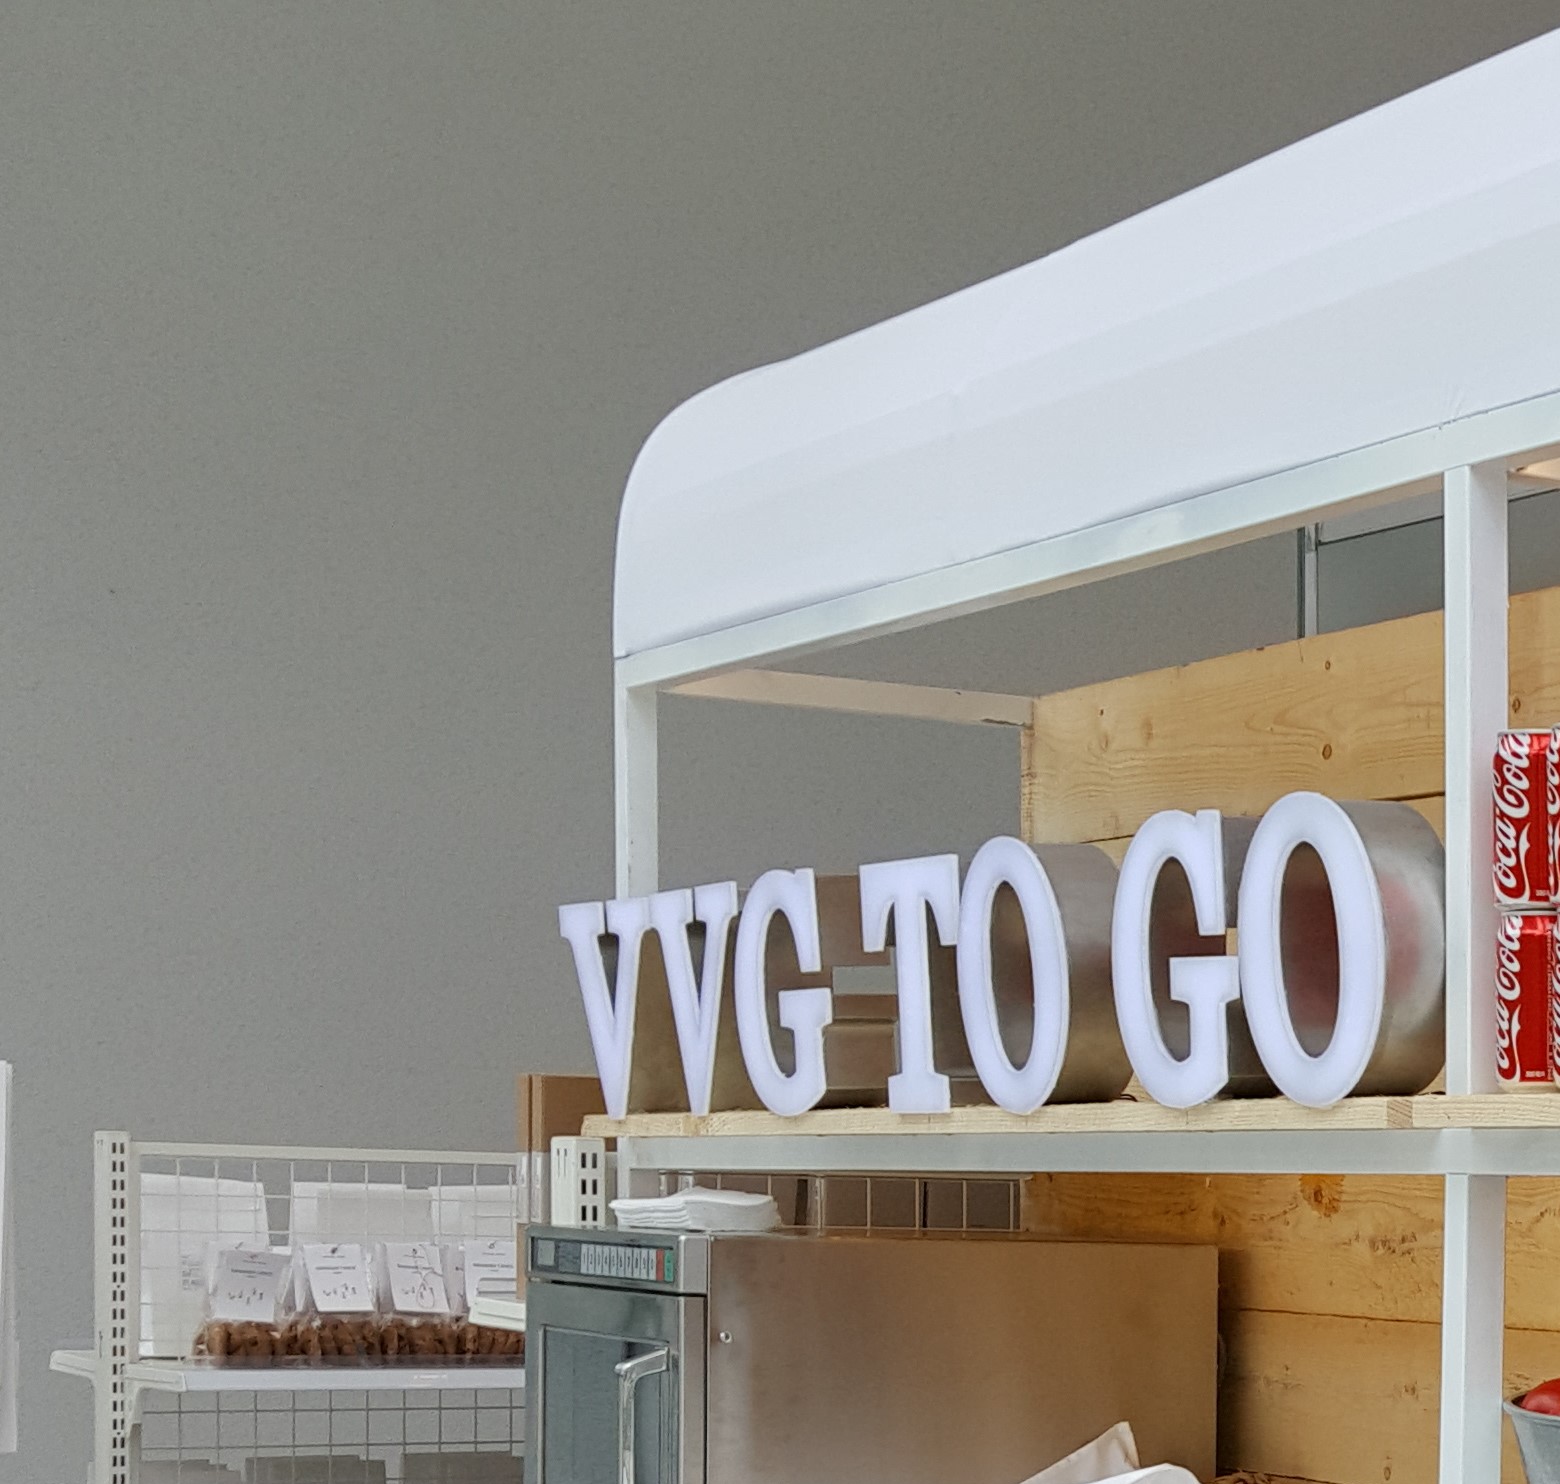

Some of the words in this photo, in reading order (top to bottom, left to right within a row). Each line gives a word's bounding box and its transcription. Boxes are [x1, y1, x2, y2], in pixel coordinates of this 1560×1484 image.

[559, 867, 832, 1120] VVG
[859, 836, 1070, 1116] TO
[1112, 791, 1387, 1109] GO
